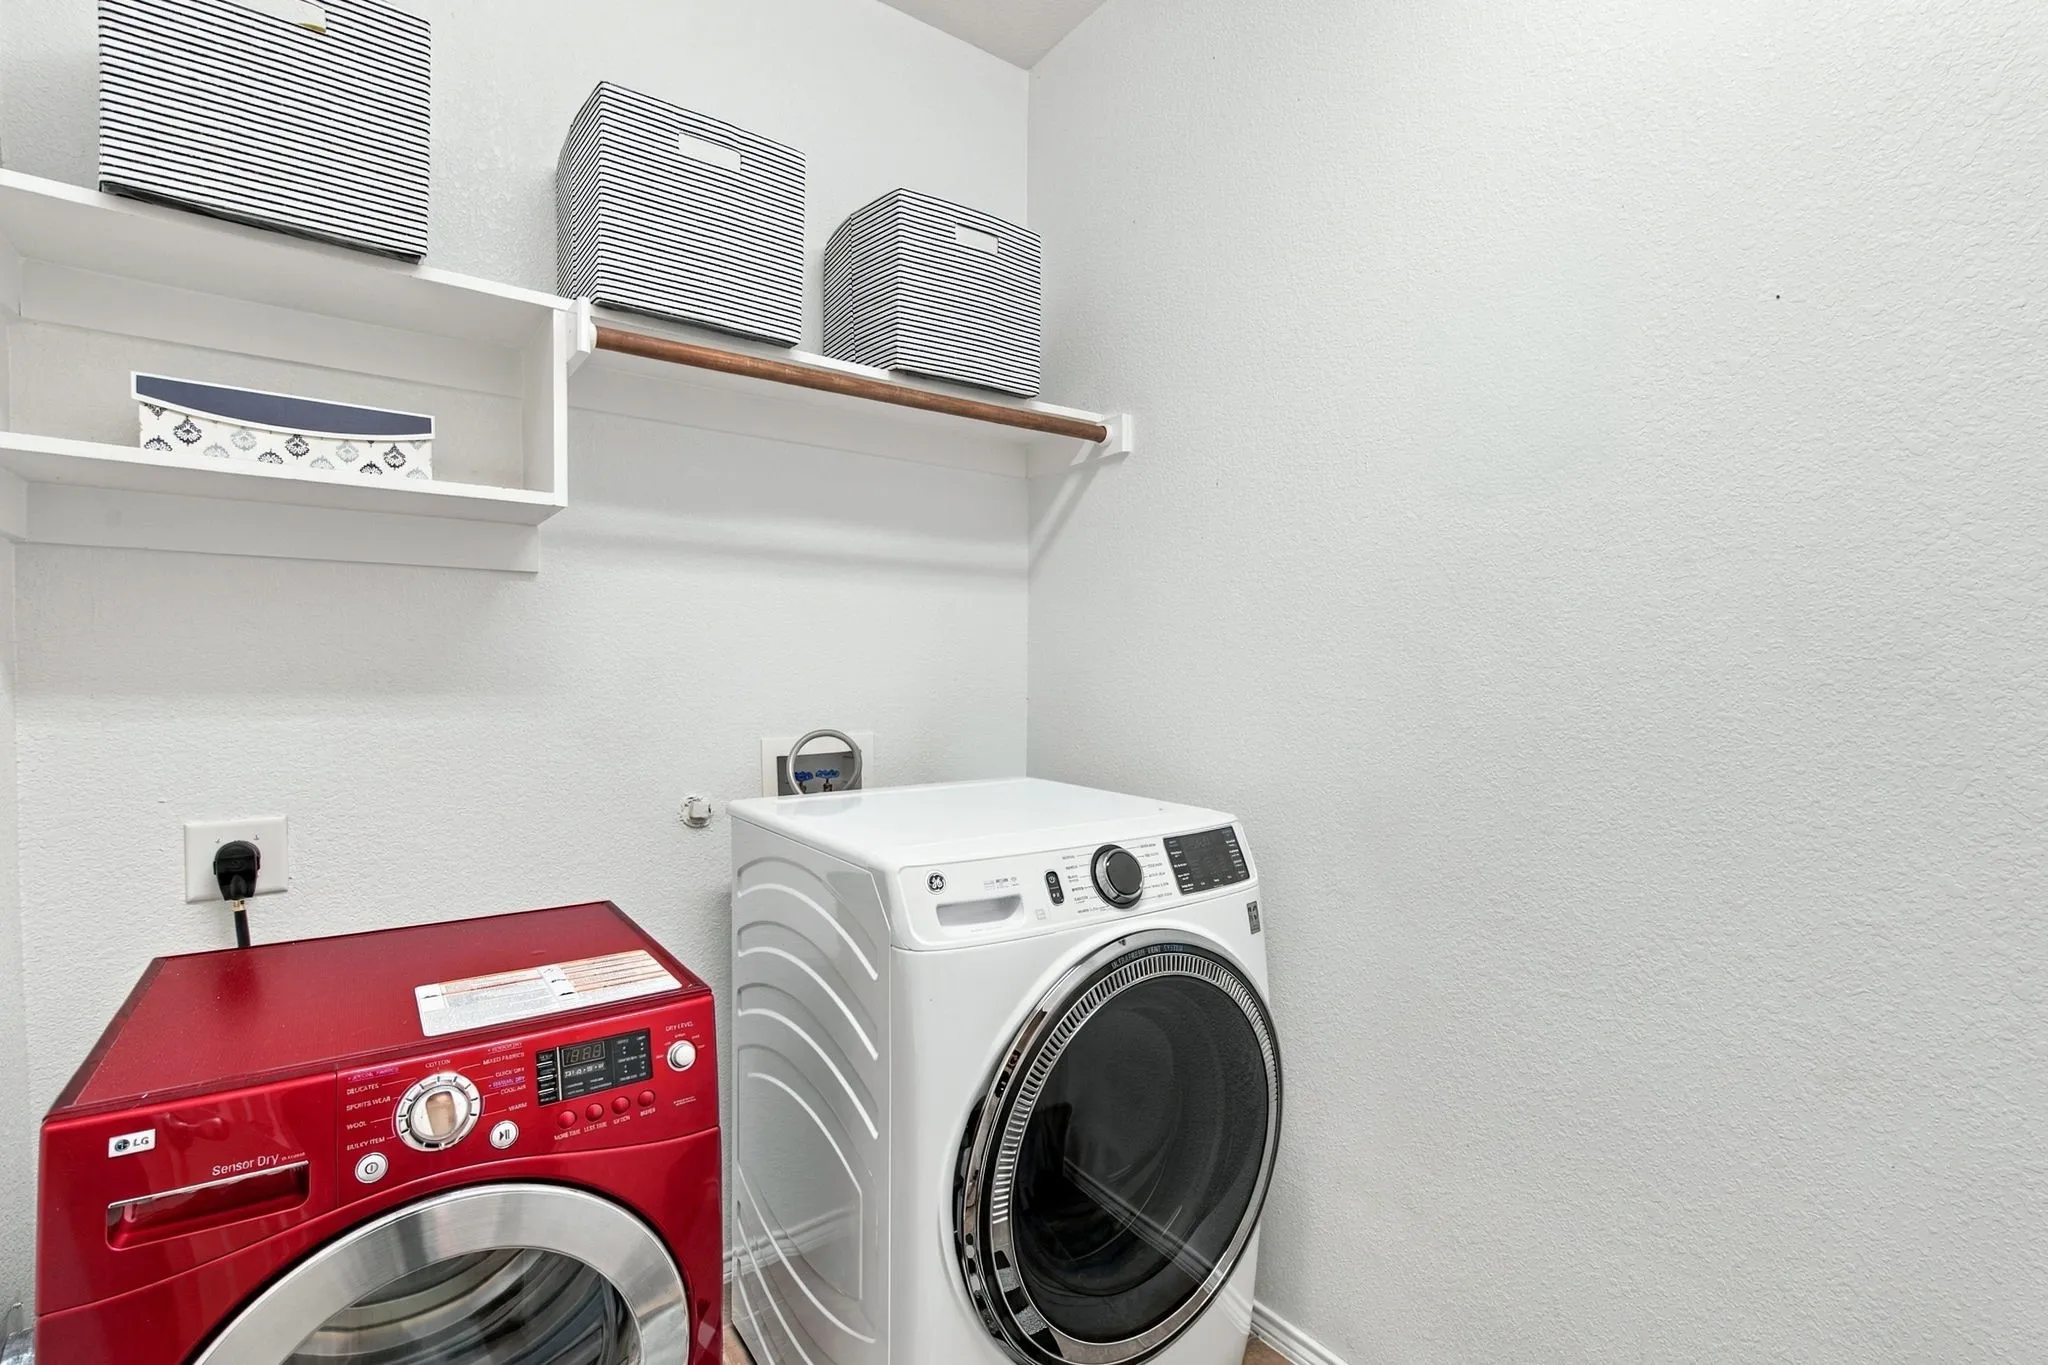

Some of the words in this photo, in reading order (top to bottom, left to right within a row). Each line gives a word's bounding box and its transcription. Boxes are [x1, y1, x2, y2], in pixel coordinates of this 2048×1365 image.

[1111, 949, 1146, 970] ULTRAFRESH
[1147, 946, 1161, 955] VENT
[425, 1059, 451, 1068] COTTON
[482, 1056, 502, 1065] MIXED
[502, 1052, 525, 1062] FABRICS
[346, 1083, 380, 1095] DELICATES
[346, 1100, 372, 1111] SPORTS
[372, 1096, 391, 1106] WEAR
[346, 1120, 367, 1130] WOOL
[132, 1135, 150, 1146] LG
[554, 1131, 569, 1140] MORE
[346, 1140, 369, 1151] BULKY
[369, 1136, 386, 1146] ITEM
[211, 1159, 256, 1176] Sensor
[256, 1152, 280, 1167] Dry
